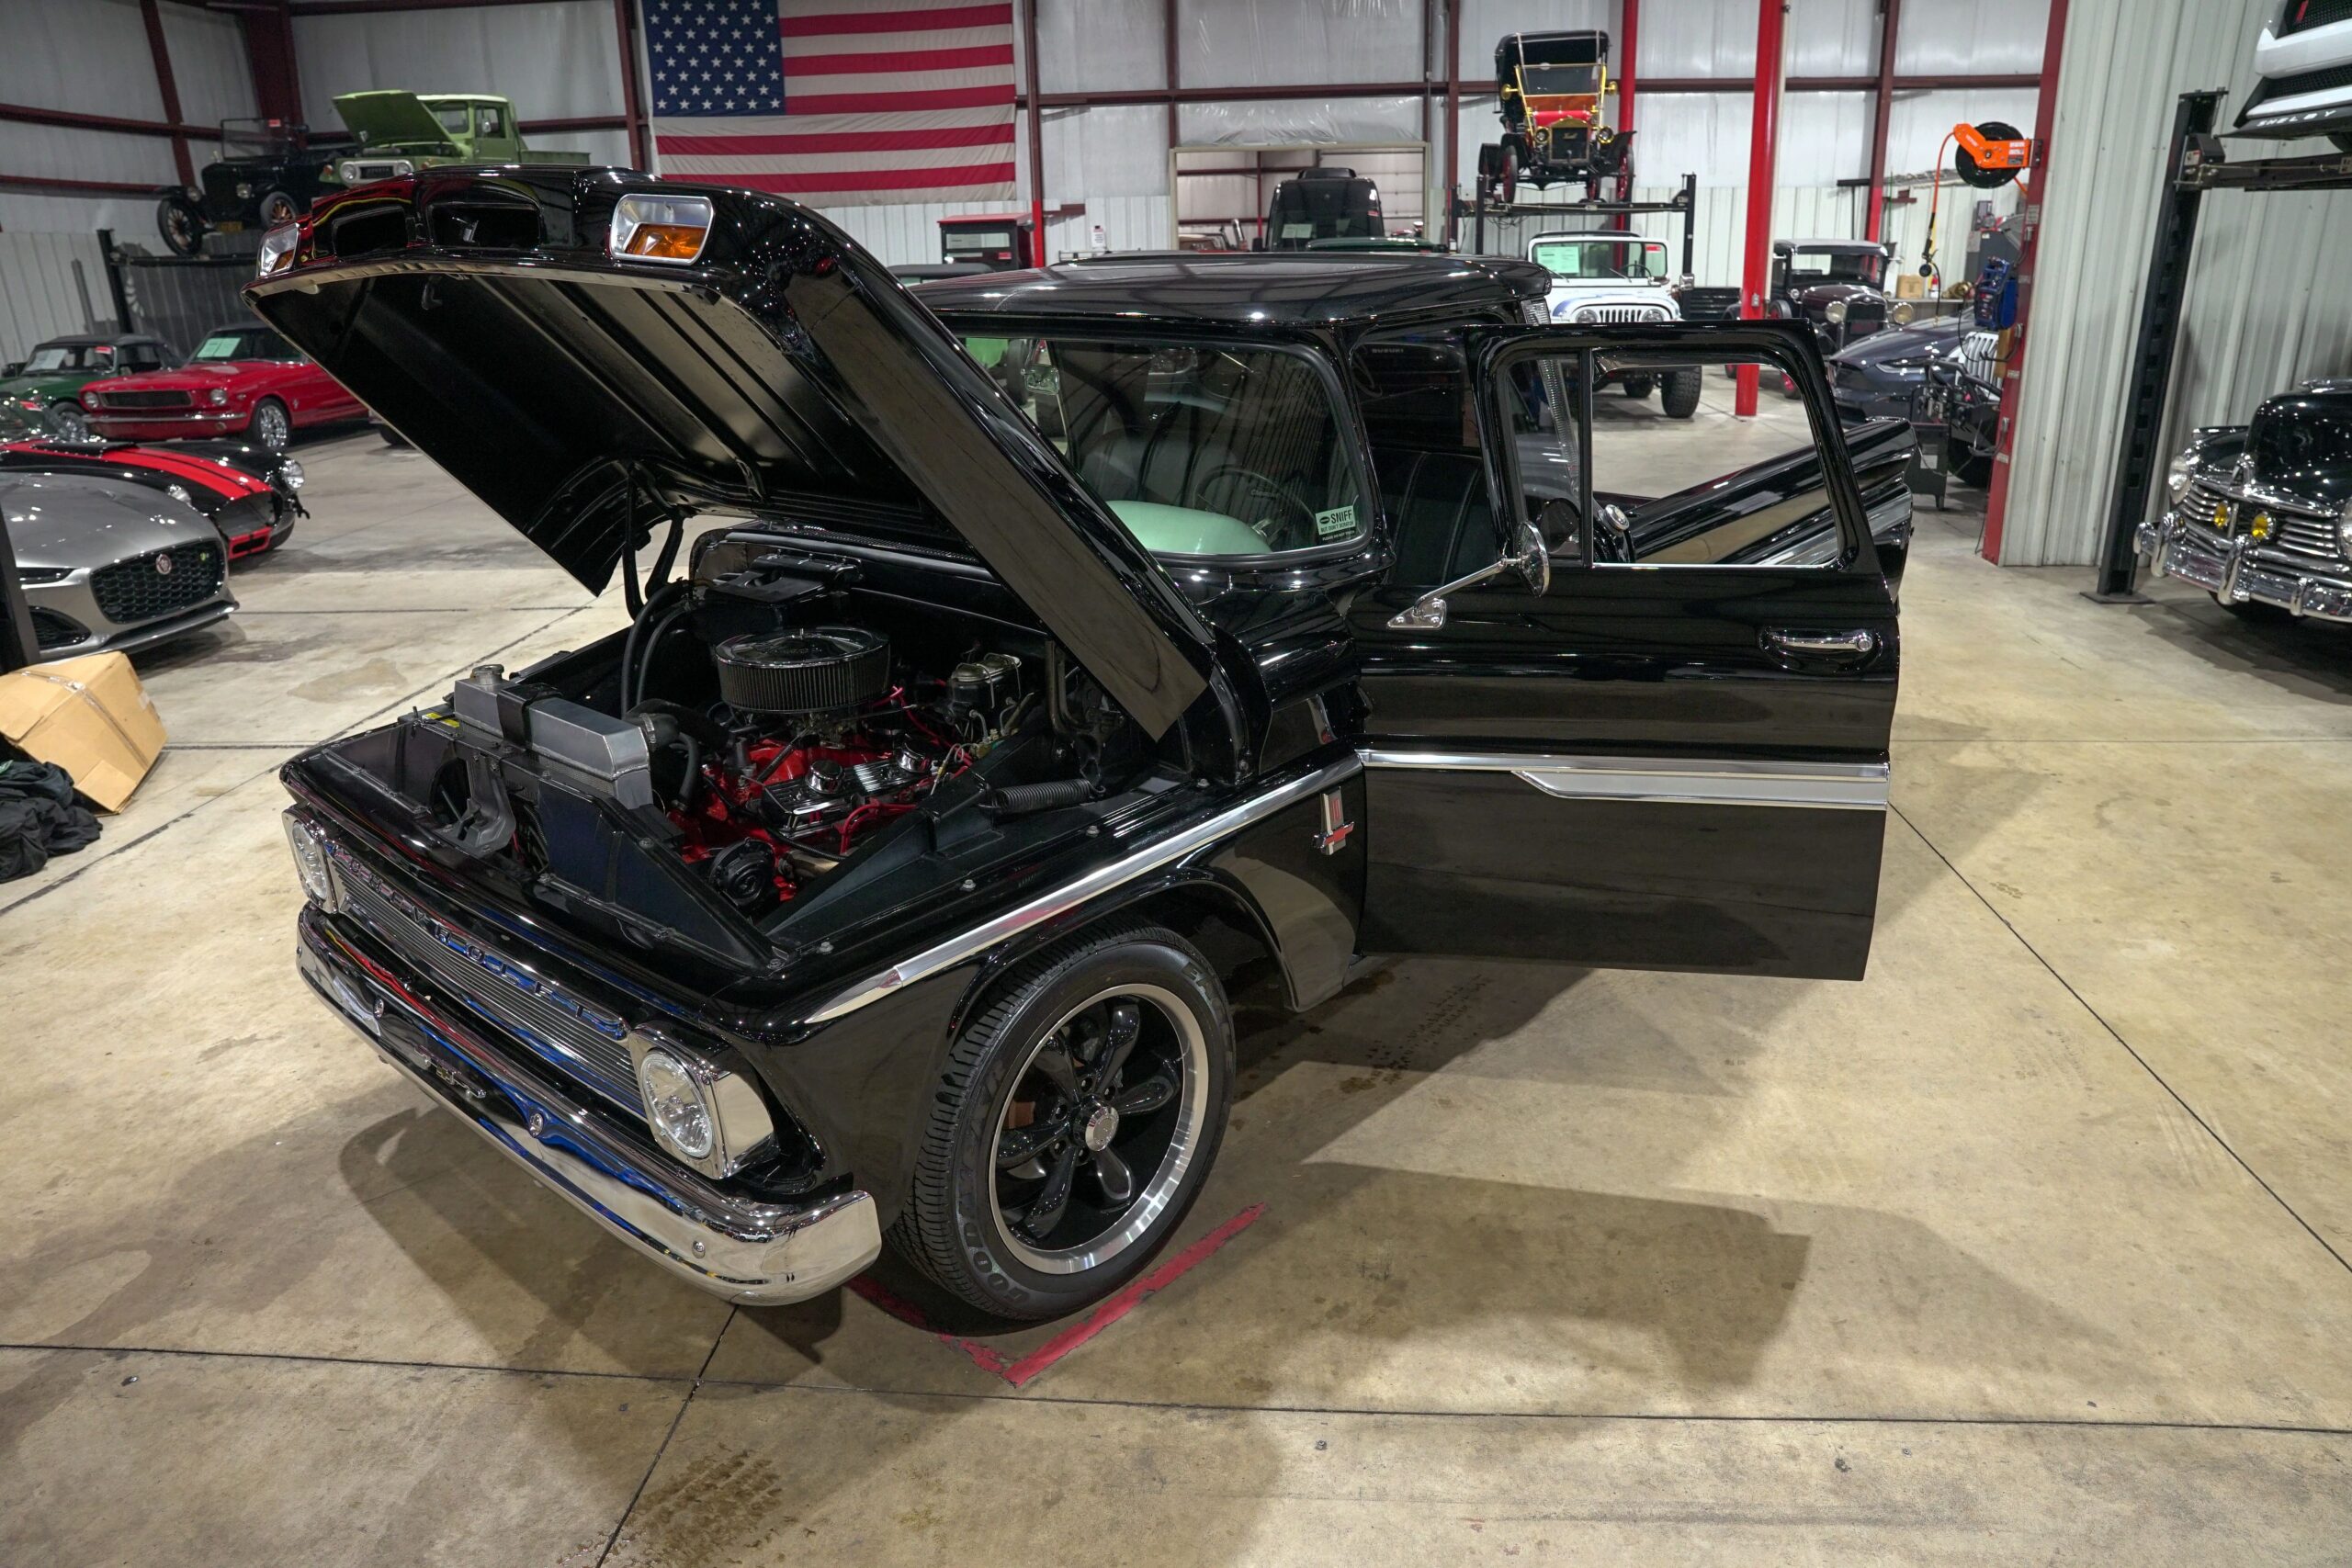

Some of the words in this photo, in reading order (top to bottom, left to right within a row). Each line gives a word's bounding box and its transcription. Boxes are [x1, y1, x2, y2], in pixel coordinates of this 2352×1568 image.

[2256, 109, 2337, 127] SHELBY
[1330, 510, 1352, 524] SNIFF
[347, 858, 589, 1019] CHEVROLET
